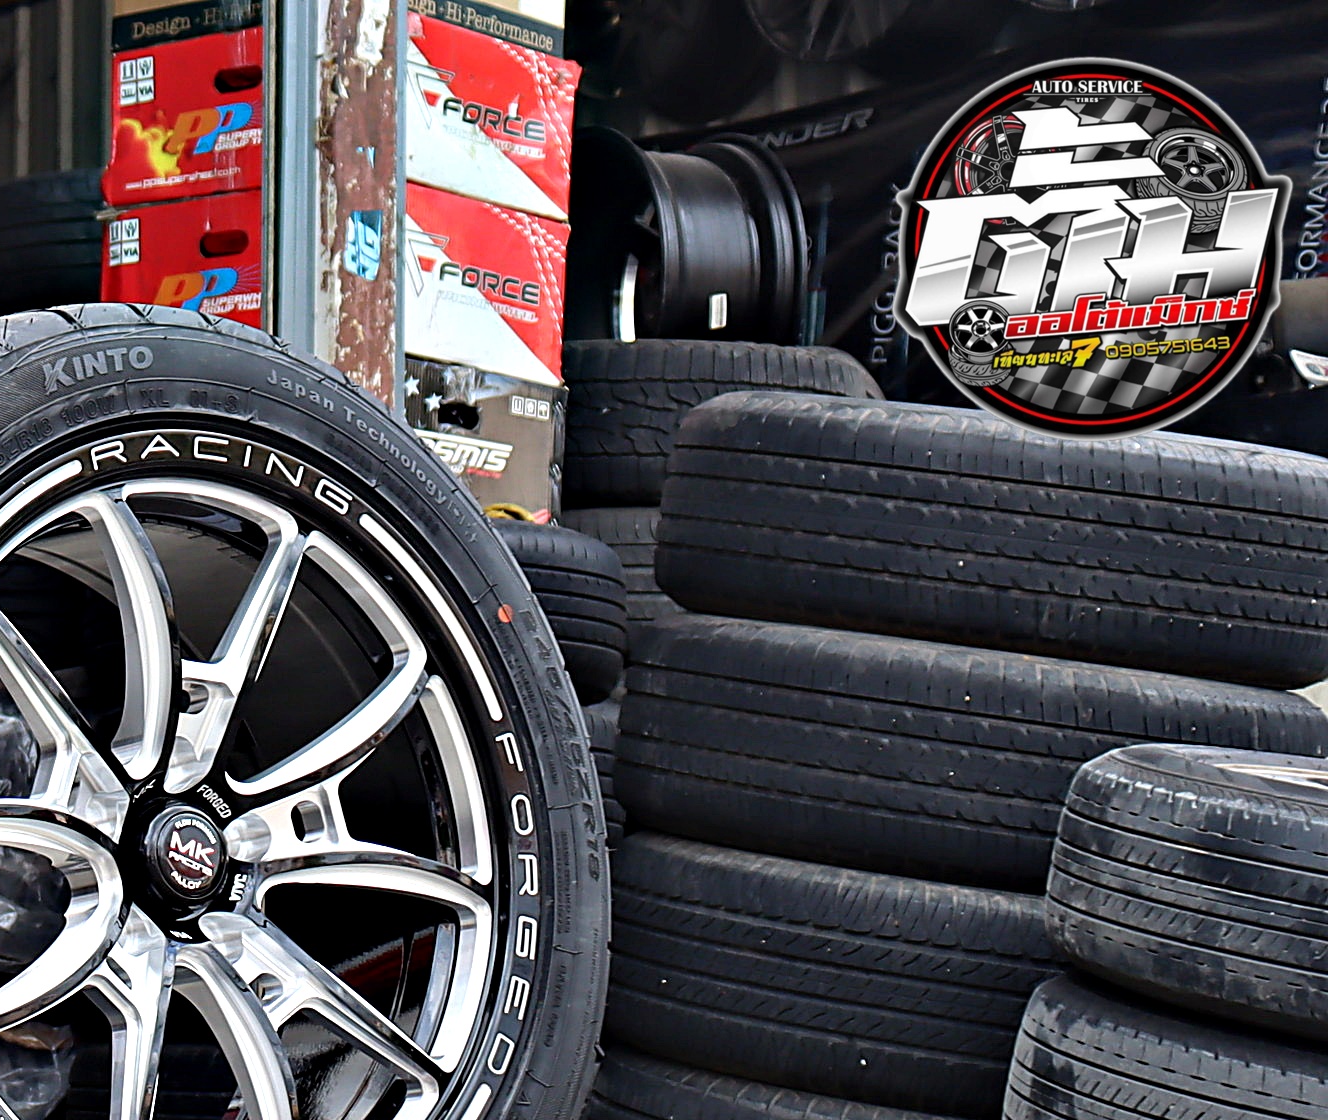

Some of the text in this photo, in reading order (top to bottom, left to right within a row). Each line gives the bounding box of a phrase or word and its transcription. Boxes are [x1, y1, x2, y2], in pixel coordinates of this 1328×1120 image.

[133, 16, 191, 39] Design
[138, 87, 154, 96] VIA
[442, 96, 546, 142] FORCE
[215, 138, 249, 151] GROUP
[124, 247, 138, 256] VIA
[438, 260, 541, 306] FORCE
[43, 346, 155, 395] KINTO
[266, 369, 447, 505] Japan Technology
[90, 434, 354, 516] RACING
[196, 784, 232, 819] FORGED
[169, 831, 215, 867] MK
[171, 870, 203, 889] ALLOY
[486, 731, 541, 1077] FORGED
